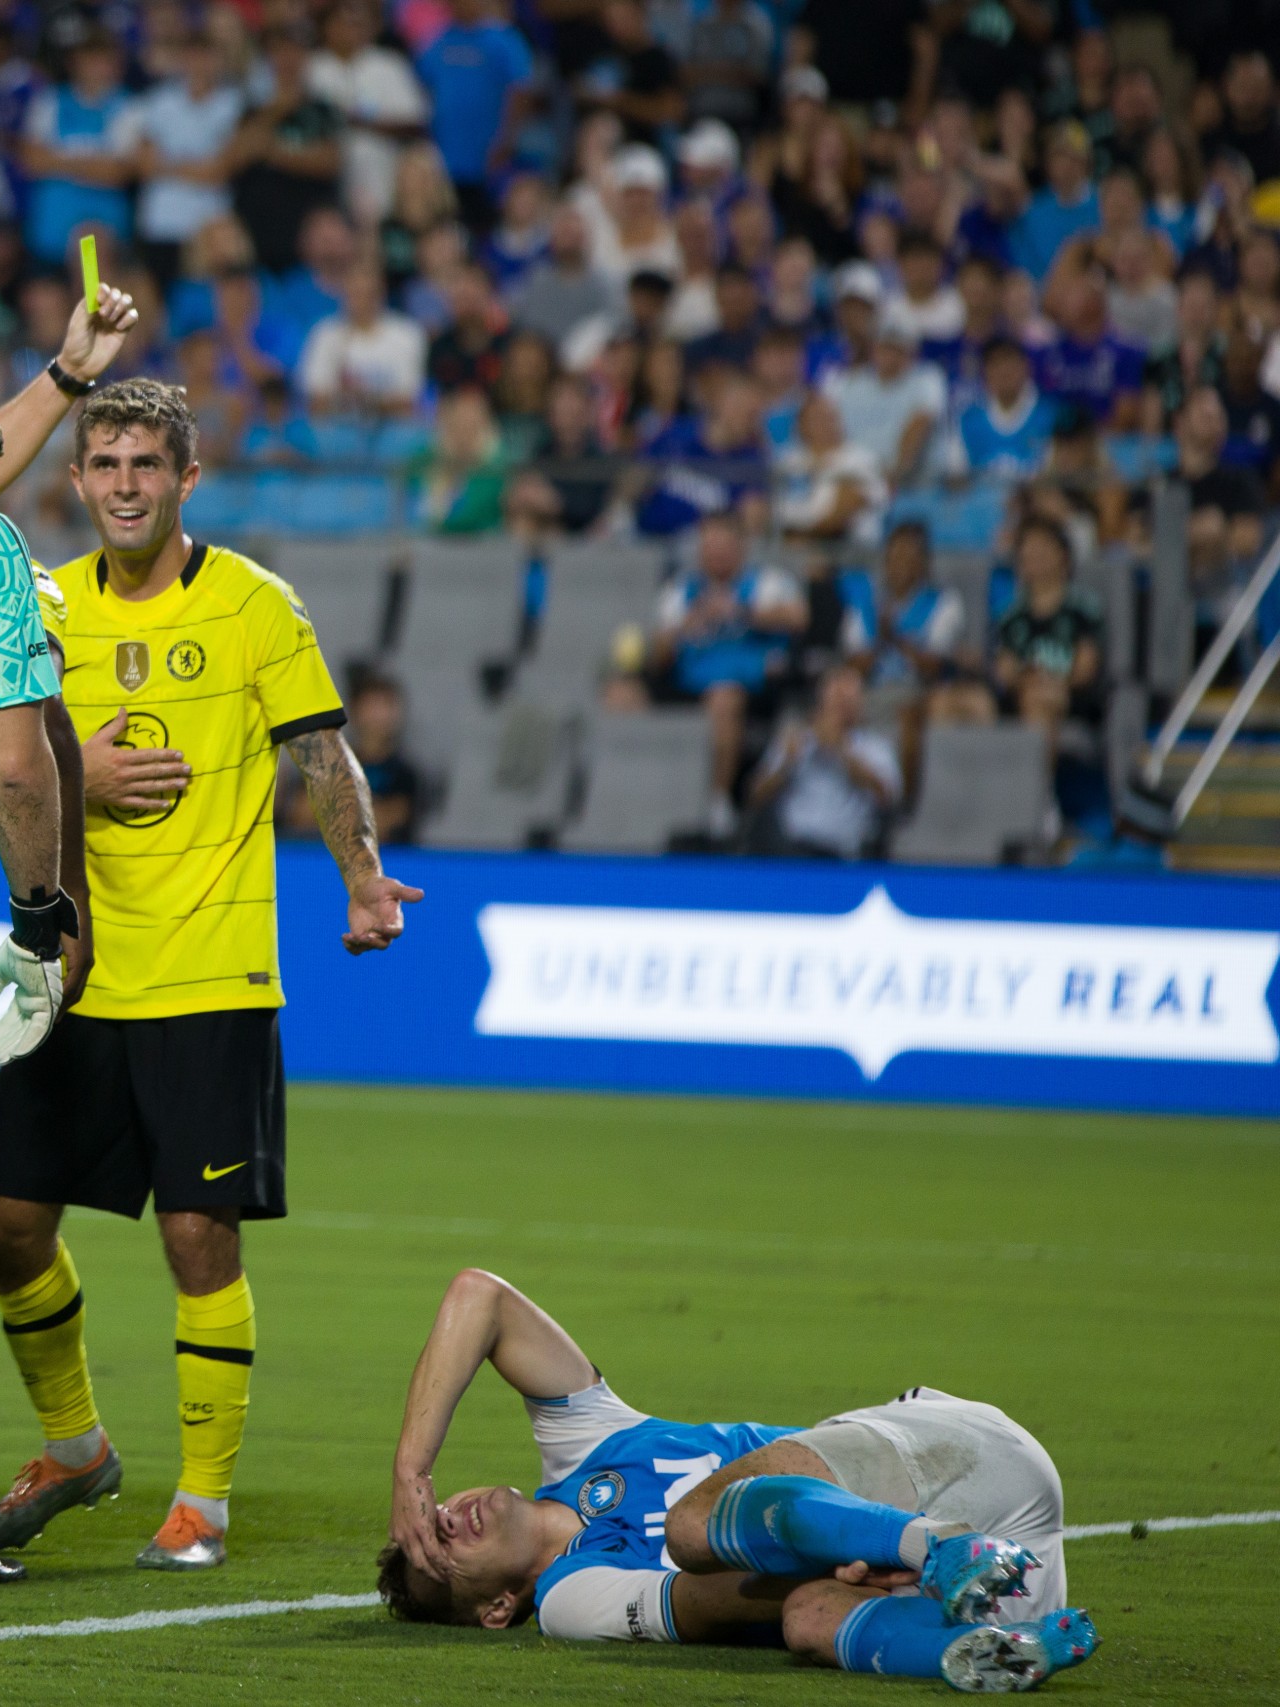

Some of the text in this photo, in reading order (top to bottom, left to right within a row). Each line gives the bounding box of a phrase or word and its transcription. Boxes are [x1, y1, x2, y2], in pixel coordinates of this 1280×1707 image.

[27, 641, 49, 658] CE
[528, 943, 1230, 1026] UNBELIEVABLY REAL
[182, 1401, 215, 1415] CFC
[626, 1600, 643, 1636] ENE
